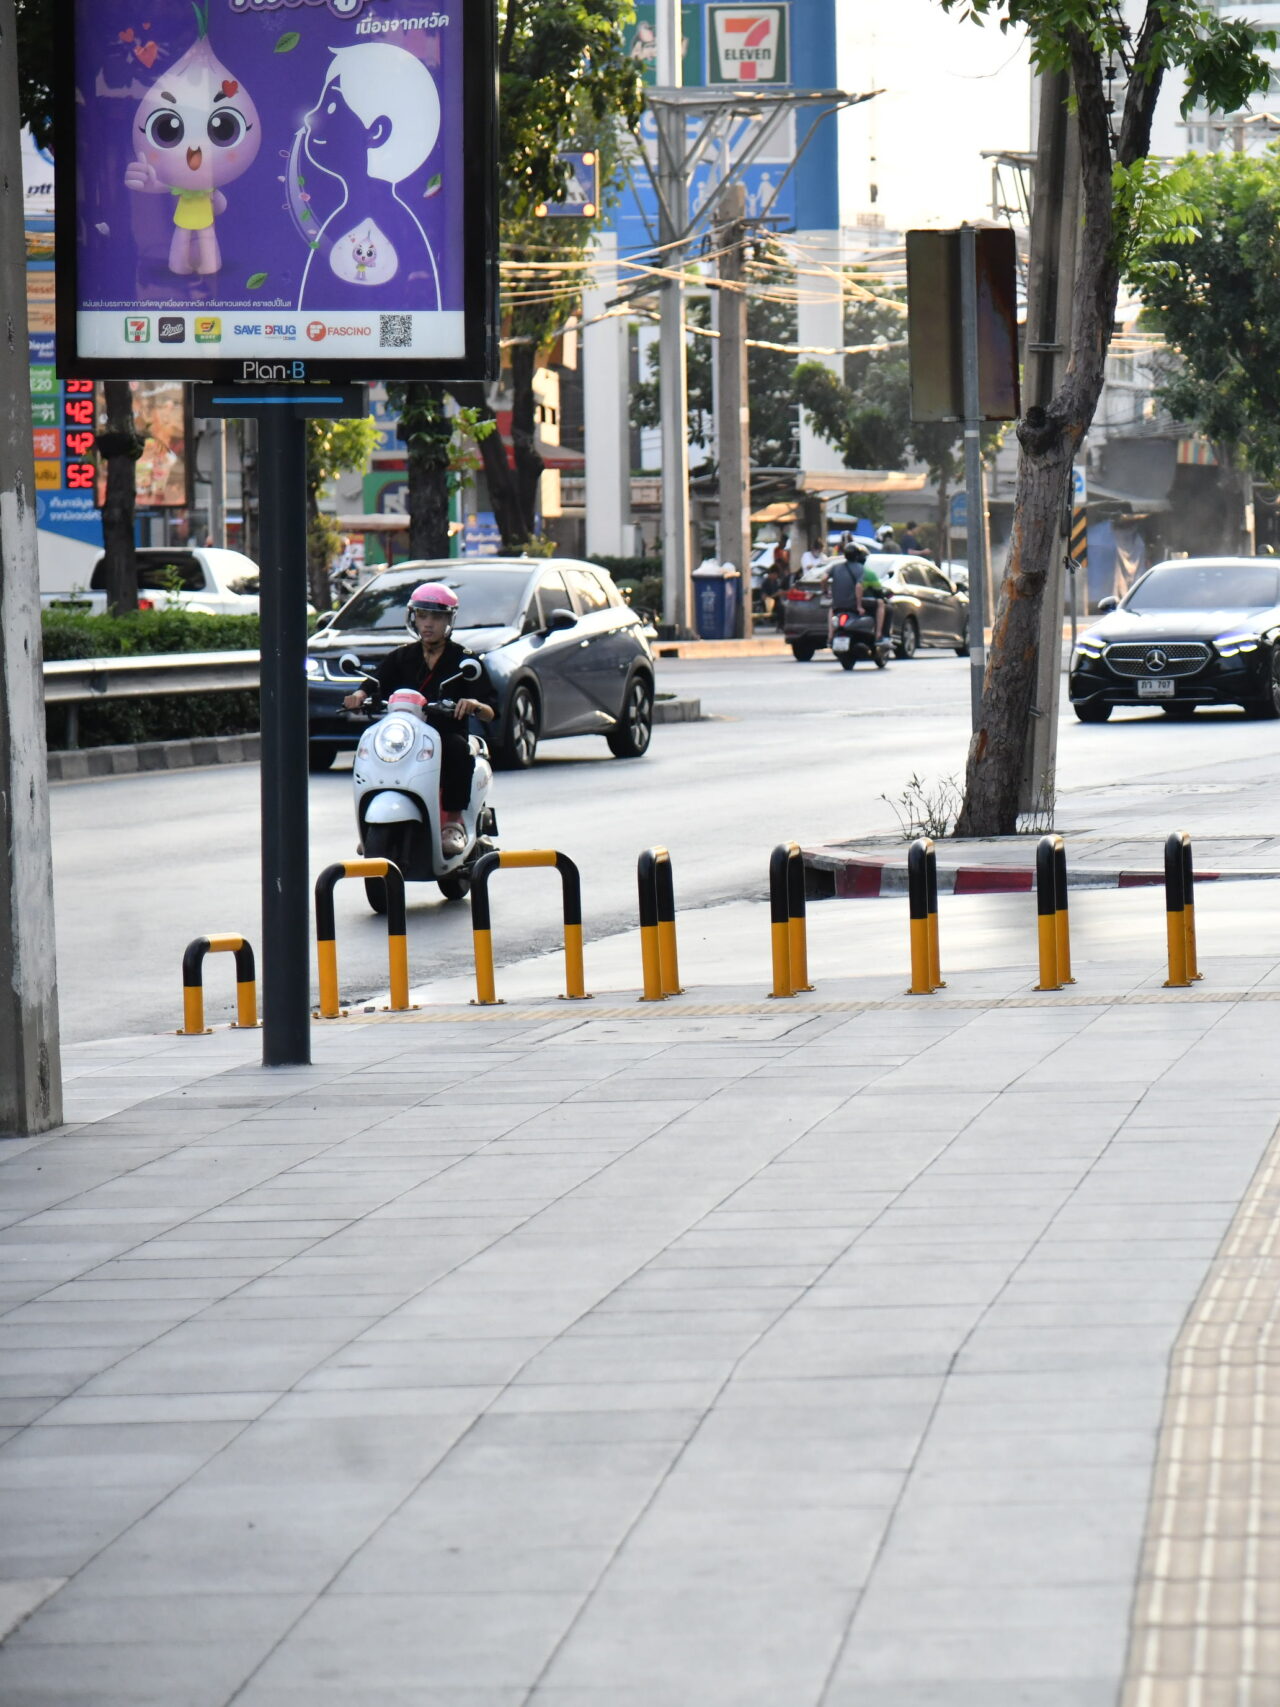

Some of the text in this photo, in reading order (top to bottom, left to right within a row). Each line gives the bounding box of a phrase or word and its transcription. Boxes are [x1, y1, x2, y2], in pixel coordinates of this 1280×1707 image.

[356, 12, 449, 35] เนื่องจากหวัด
[234, 325, 296, 335] SAVE DRUG
[327, 327, 371, 336] FASCINO
[66, 400, 94, 424] 42
[66, 463, 95, 488] 52
